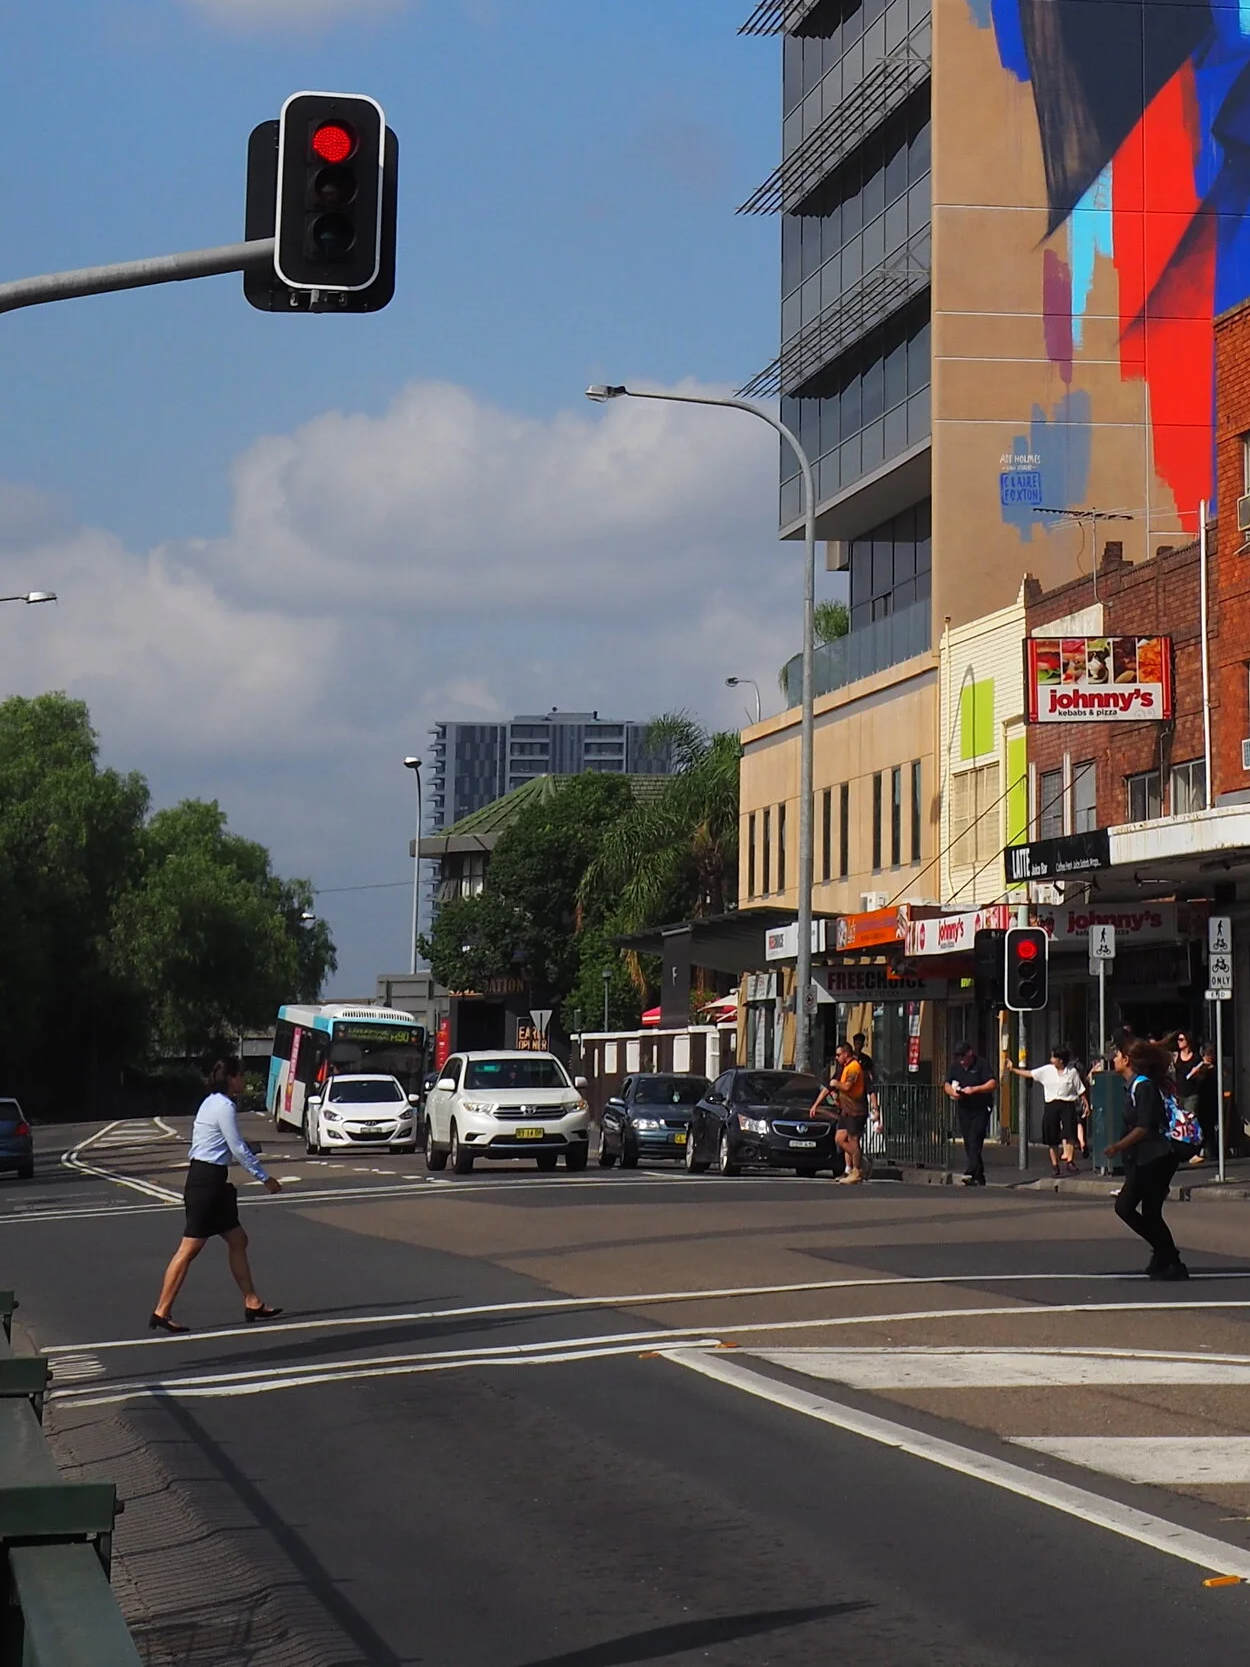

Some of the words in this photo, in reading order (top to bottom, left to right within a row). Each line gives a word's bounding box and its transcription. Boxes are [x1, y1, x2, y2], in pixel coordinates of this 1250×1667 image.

[1004, 475, 1038, 488] CLAIRE
[1004, 488, 1039, 502] FOXTON
[1049, 688, 1154, 713] johnny's
[1058, 709, 1087, 717] kebabs
[1096, 708, 1117, 718] pizza
[1012, 848, 1031, 880] LATTE
[1067, 909, 1162, 934] johnny's
[938, 918, 964, 946] johnny's
[1211, 976, 1231, 986] ONLY
